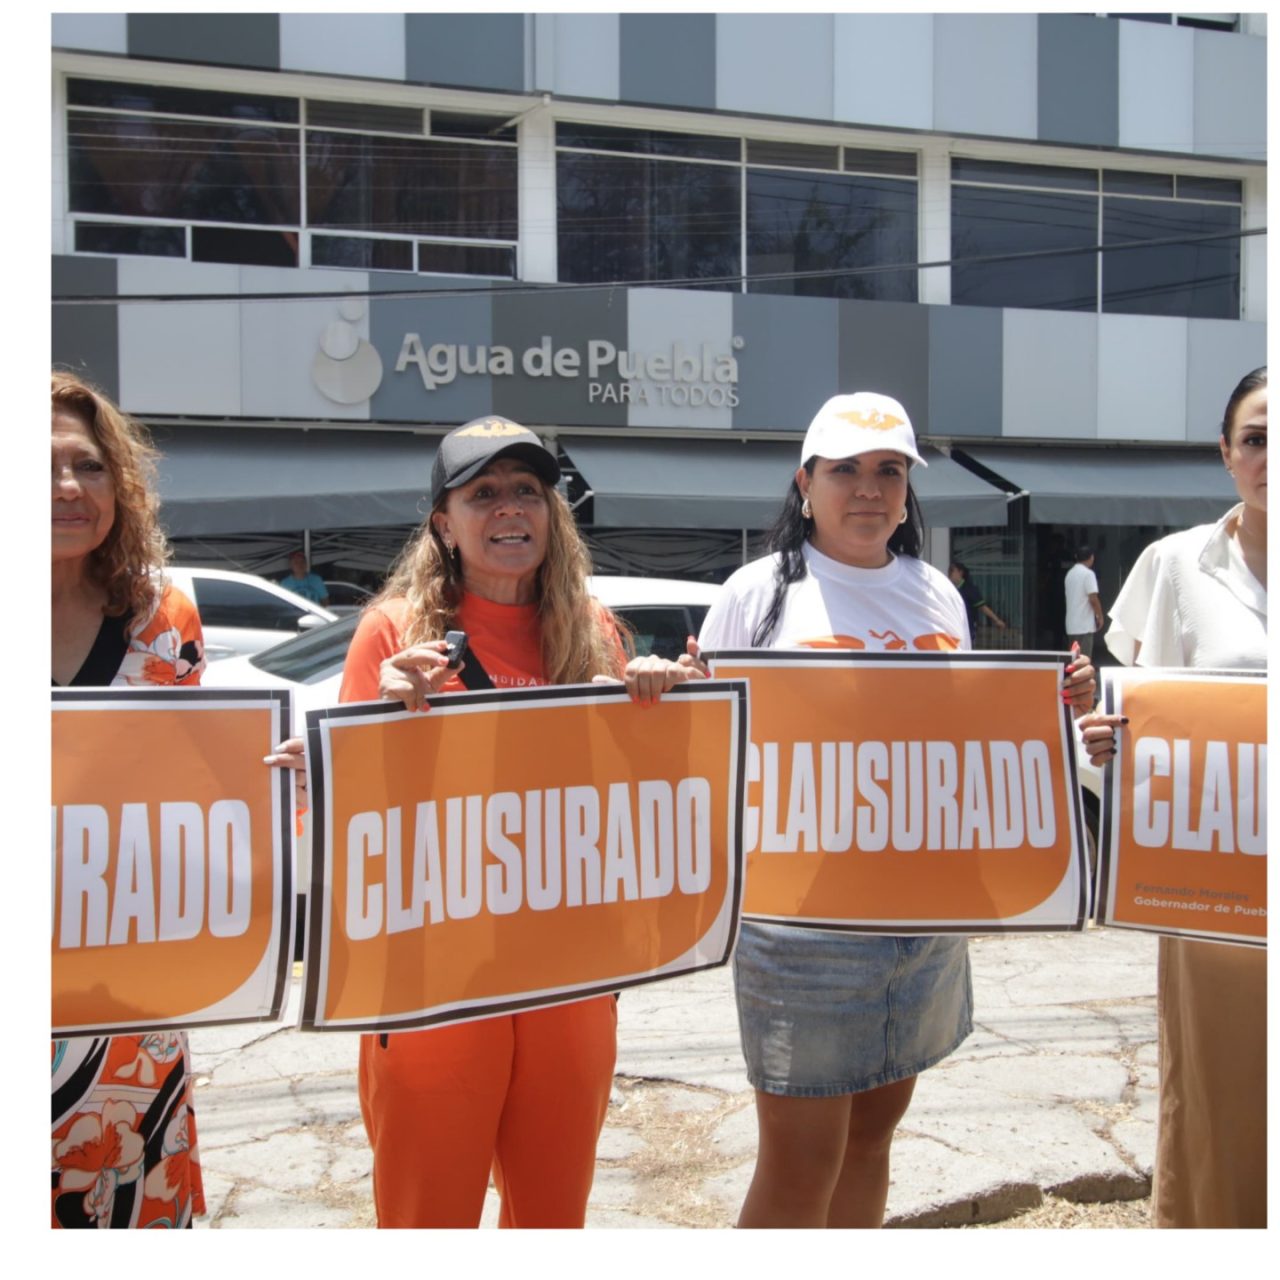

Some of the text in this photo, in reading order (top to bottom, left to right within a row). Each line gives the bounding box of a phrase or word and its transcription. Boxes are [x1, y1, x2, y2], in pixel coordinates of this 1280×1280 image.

[395, 333, 739, 390] Agua de Puebla
[588, 382, 740, 408] PARA TODOS
[52, 799, 252, 949] RADO
[345, 777, 711, 941] CLAUSURADO
[1134, 896, 1210, 911] Gobernador
[1214, 903, 1231, 913] de
